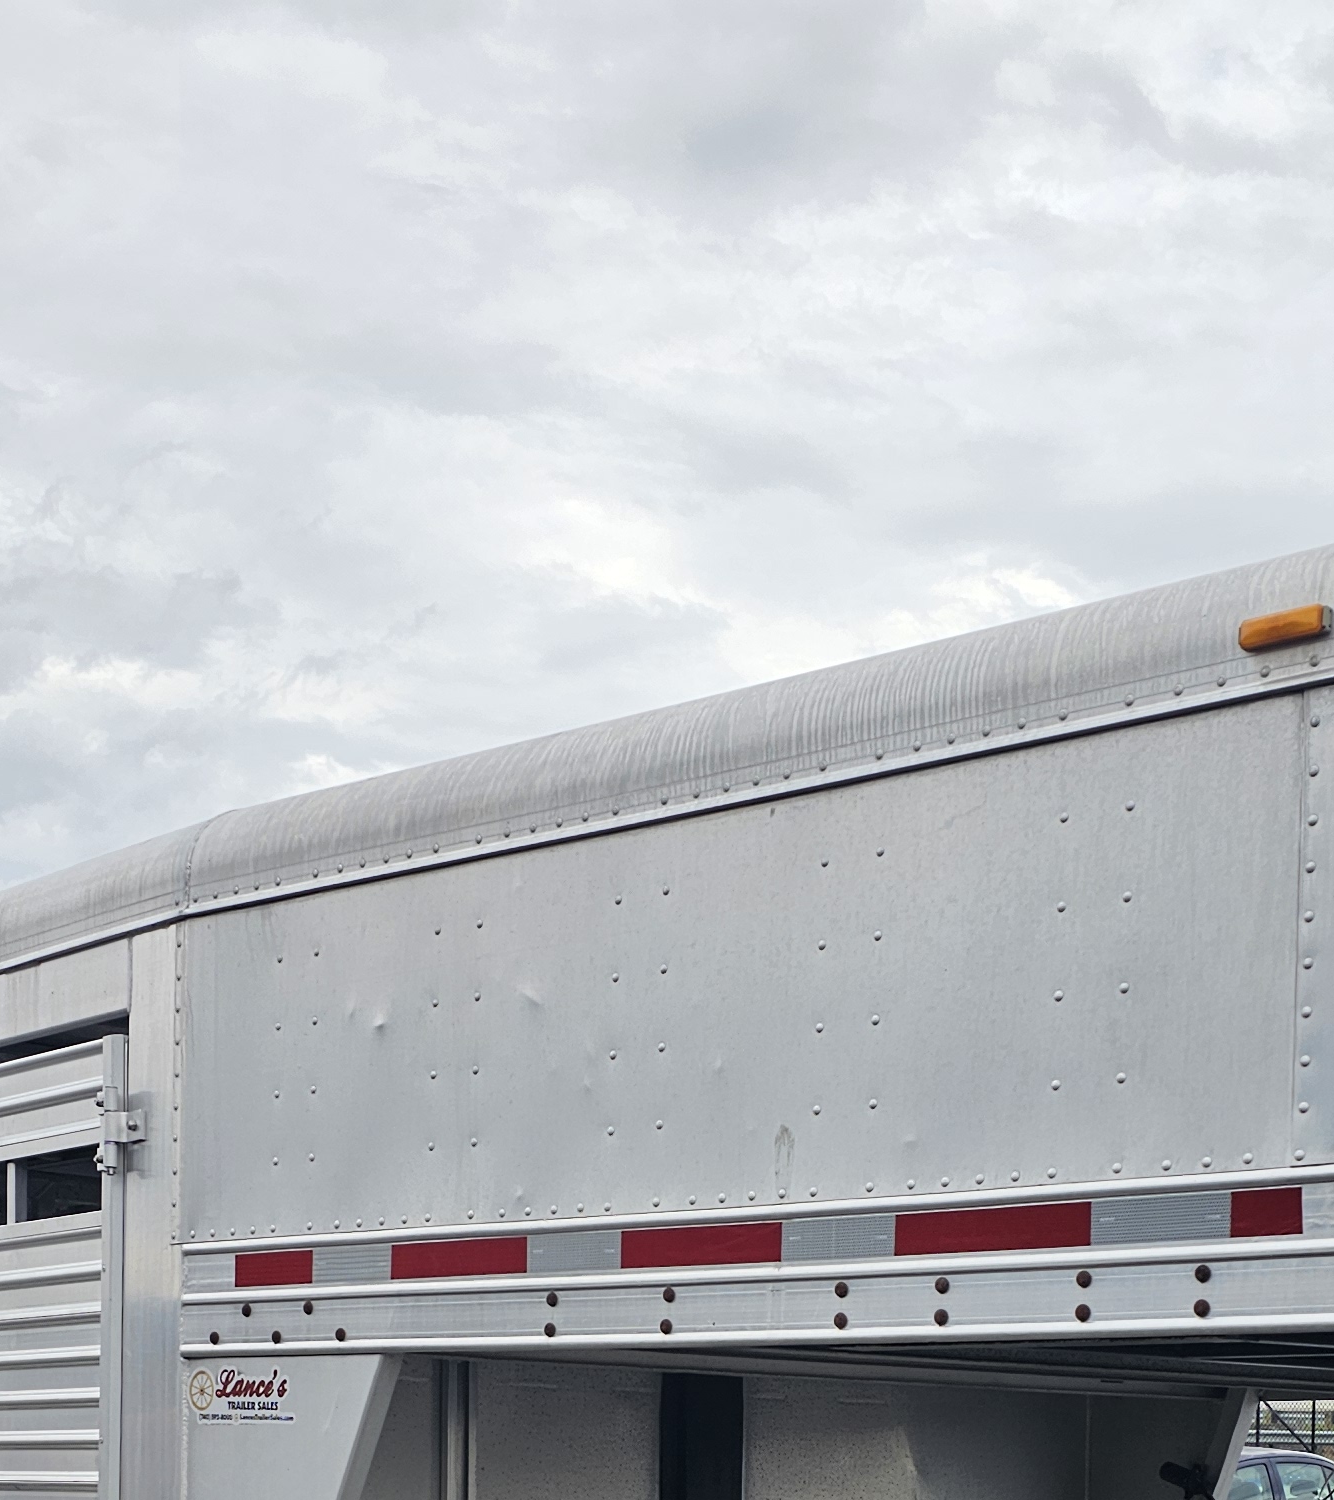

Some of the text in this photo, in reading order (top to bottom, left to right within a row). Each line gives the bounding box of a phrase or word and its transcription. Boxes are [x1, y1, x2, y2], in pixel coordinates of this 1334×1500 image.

[216, 1369, 287, 1398] Lance's
[227, 1401, 279, 1410] TRAILER SALES
